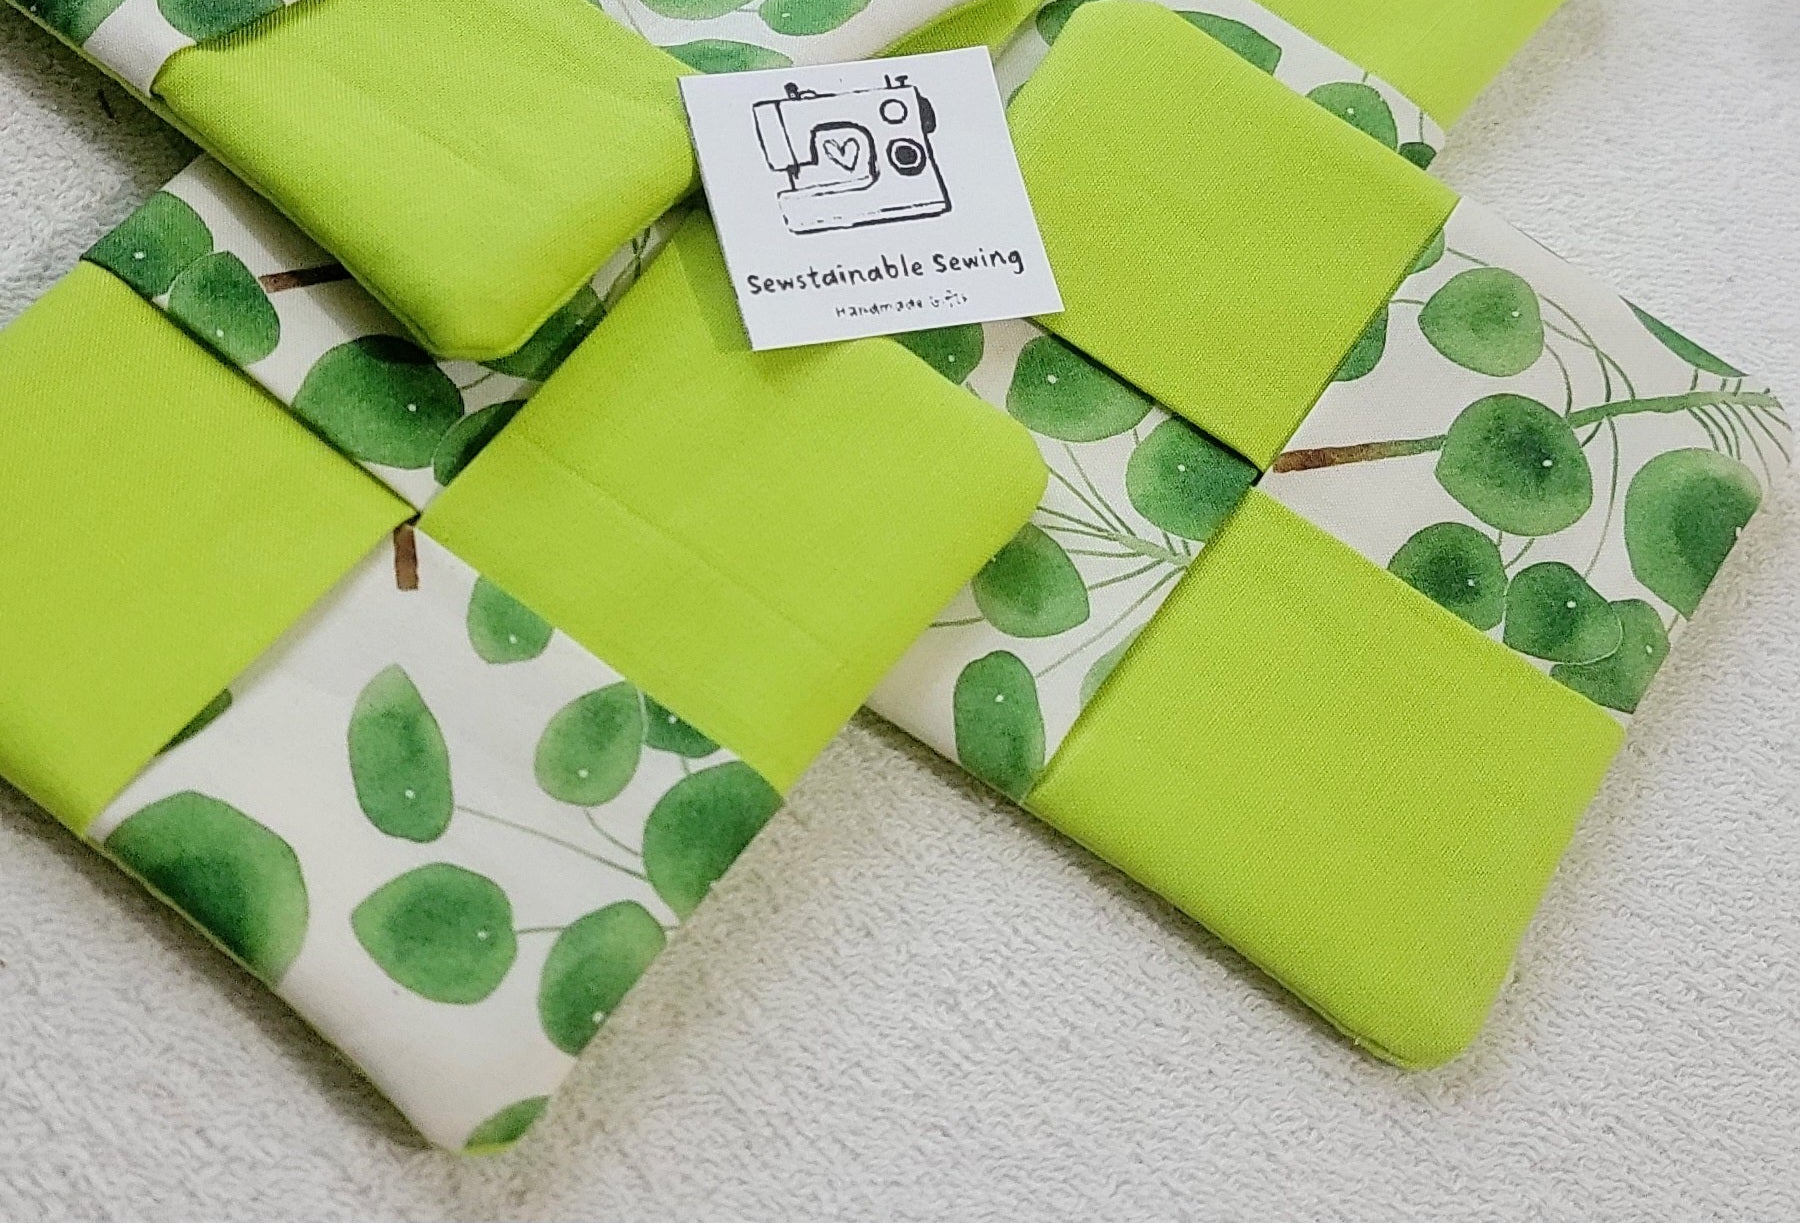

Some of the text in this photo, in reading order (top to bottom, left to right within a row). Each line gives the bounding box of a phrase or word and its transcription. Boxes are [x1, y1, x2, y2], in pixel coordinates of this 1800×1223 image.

[746, 246, 1025, 296] Sewstainable Sewing
[835, 297, 923, 318] Handmade
